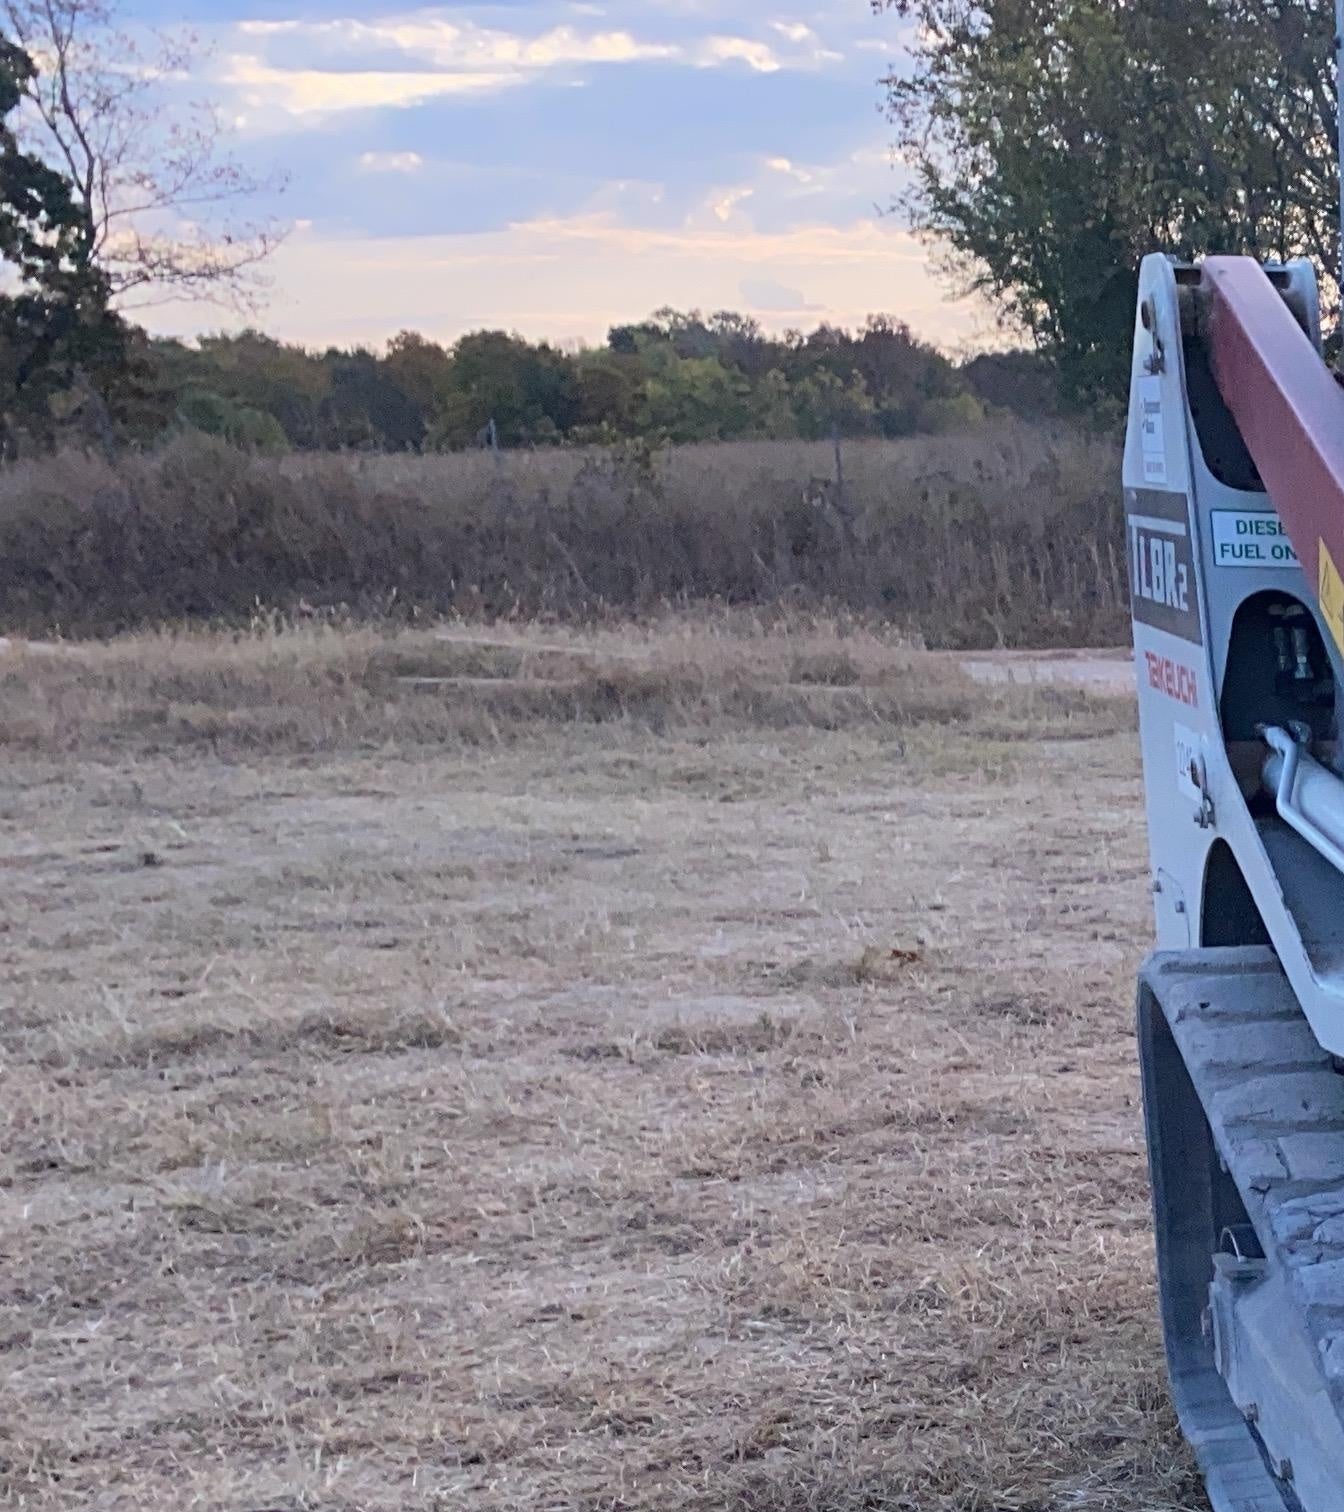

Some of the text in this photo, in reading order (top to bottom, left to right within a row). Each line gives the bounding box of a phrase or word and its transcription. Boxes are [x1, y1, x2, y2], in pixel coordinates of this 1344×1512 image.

[1236, 519, 1287, 536] DIESE
[1220, 543, 1298, 560] FUEL ON
